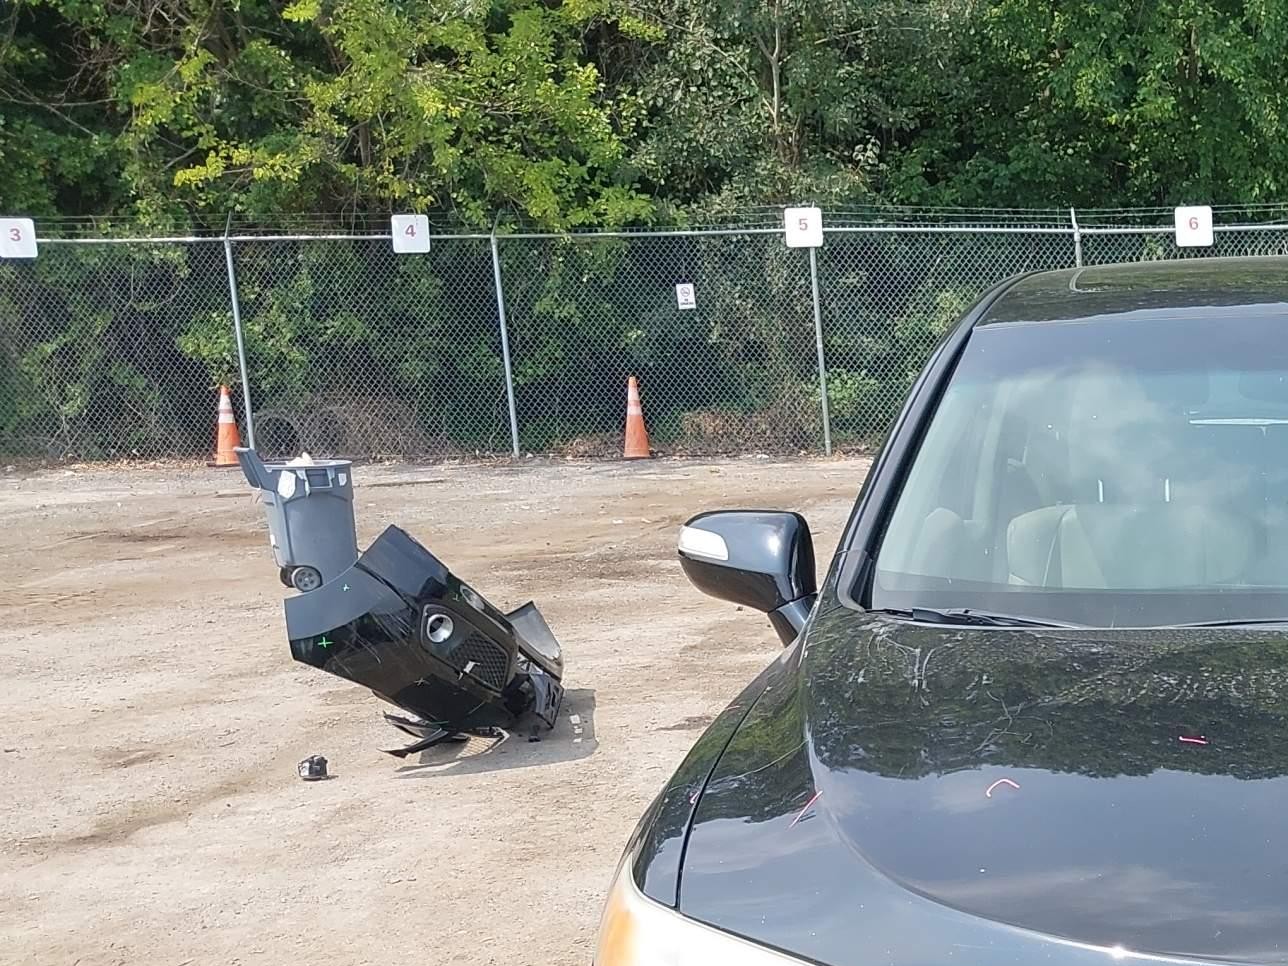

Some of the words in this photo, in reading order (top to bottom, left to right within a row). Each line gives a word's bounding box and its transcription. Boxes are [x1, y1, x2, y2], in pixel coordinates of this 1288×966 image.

[799, 218, 808, 231] 5
[1188, 217, 1199, 230] 6
[9, 228, 22, 242] 3
[405, 224, 417, 238] 4
